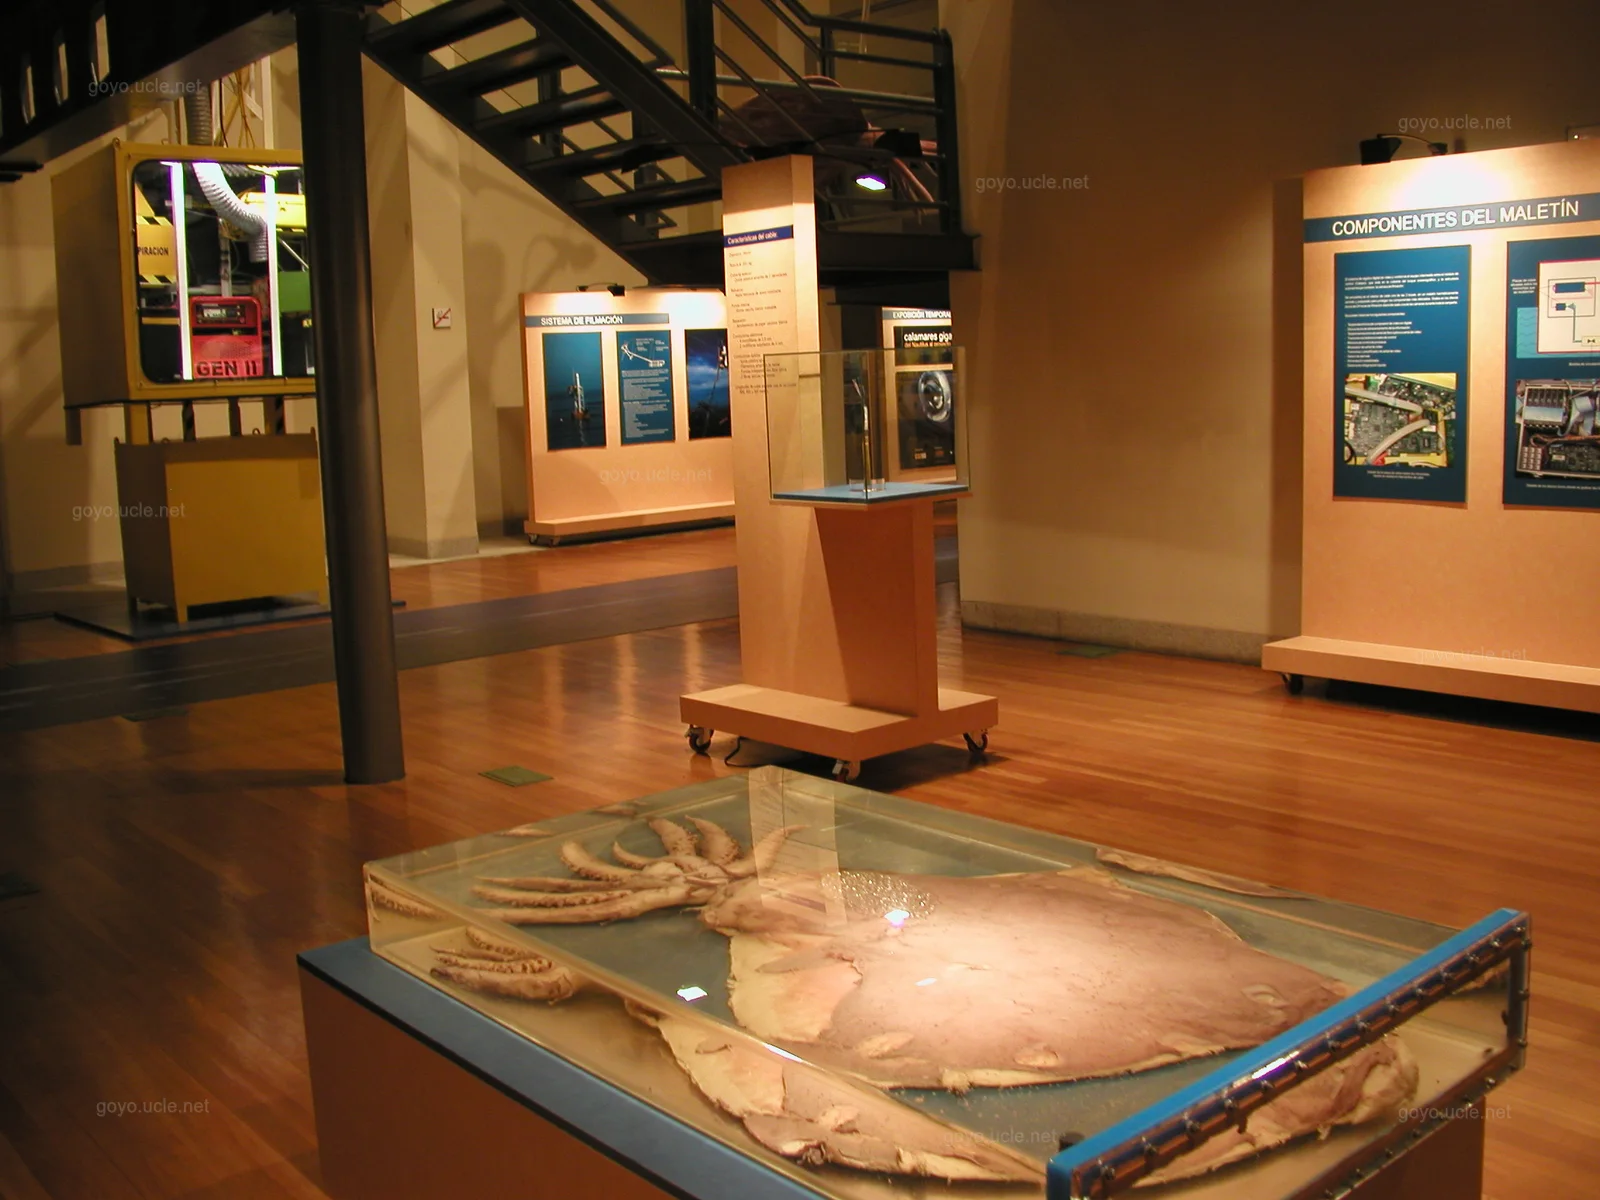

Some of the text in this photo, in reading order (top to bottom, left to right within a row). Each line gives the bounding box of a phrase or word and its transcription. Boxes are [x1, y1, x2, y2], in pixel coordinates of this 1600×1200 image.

[1332, 198, 1580, 236] COMPONENTES DEL MALETÍN
[540, 315, 623, 326] SISTEMA DE FILMACIÓN
[903, 331, 938, 342] calamares
[196, 361, 238, 377] GEN
